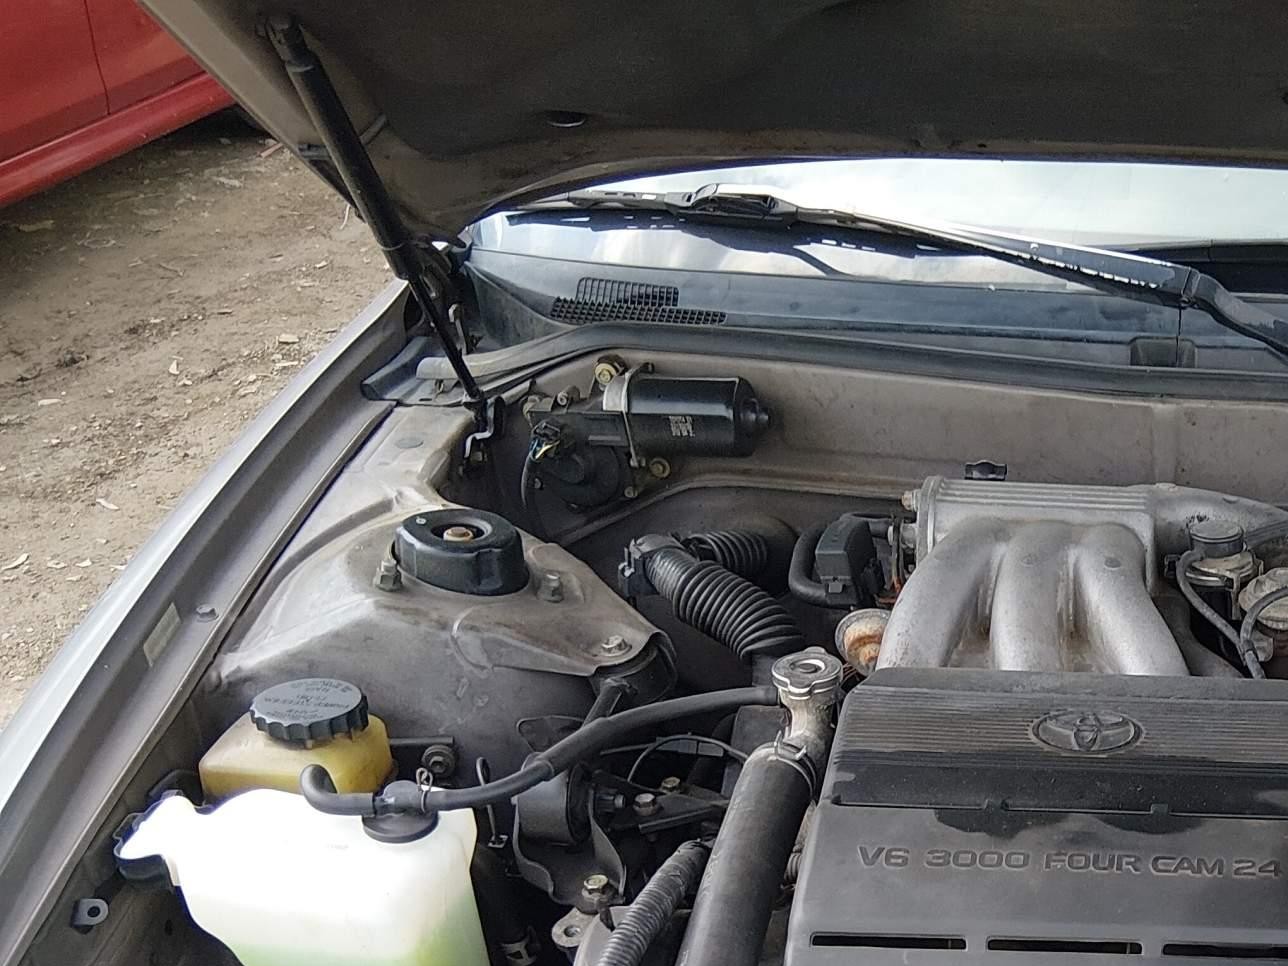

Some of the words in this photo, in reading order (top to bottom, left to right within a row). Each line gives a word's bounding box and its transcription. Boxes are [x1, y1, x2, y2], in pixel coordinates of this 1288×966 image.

[858, 845, 910, 867] V6
[924, 849, 1030, 869] 3000
[1043, 851, 1142, 873] FOUR
[1150, 855, 1225, 877] CAM
[1232, 859, 1284, 879] 24
